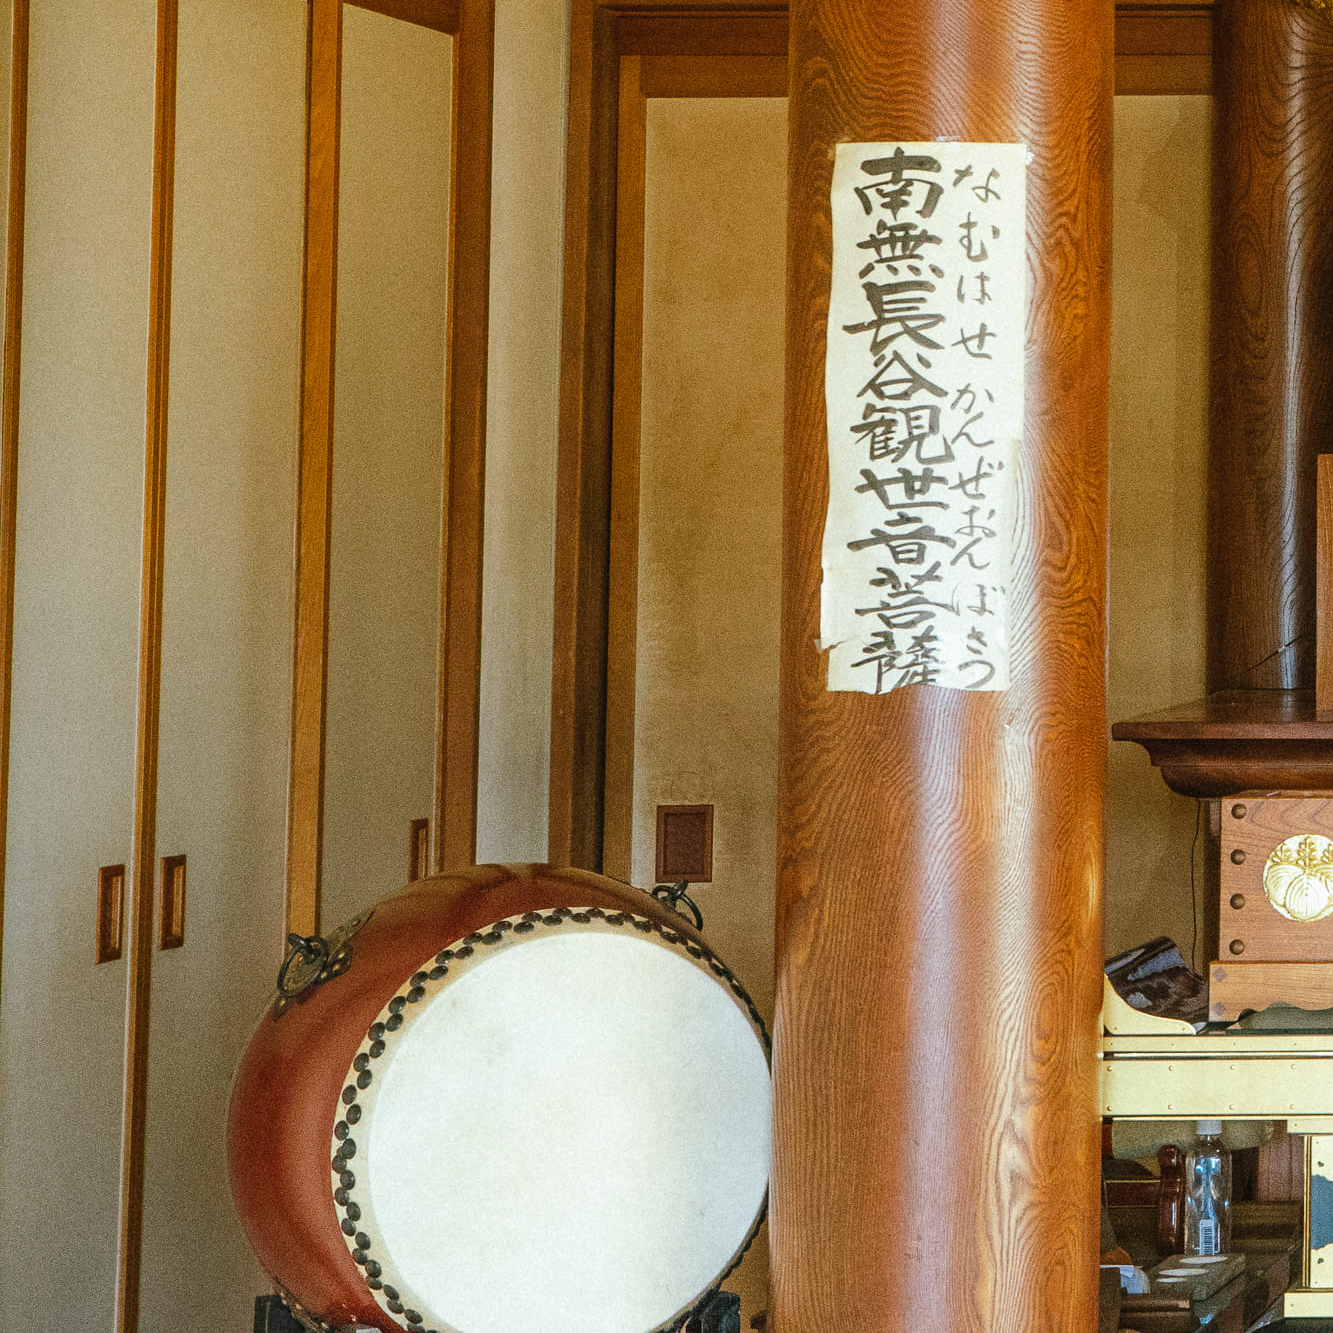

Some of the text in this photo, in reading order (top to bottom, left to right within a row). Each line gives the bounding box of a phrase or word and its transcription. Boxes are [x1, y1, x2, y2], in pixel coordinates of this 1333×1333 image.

[843, 147, 956, 694] 南無長谷観世音菩薩
